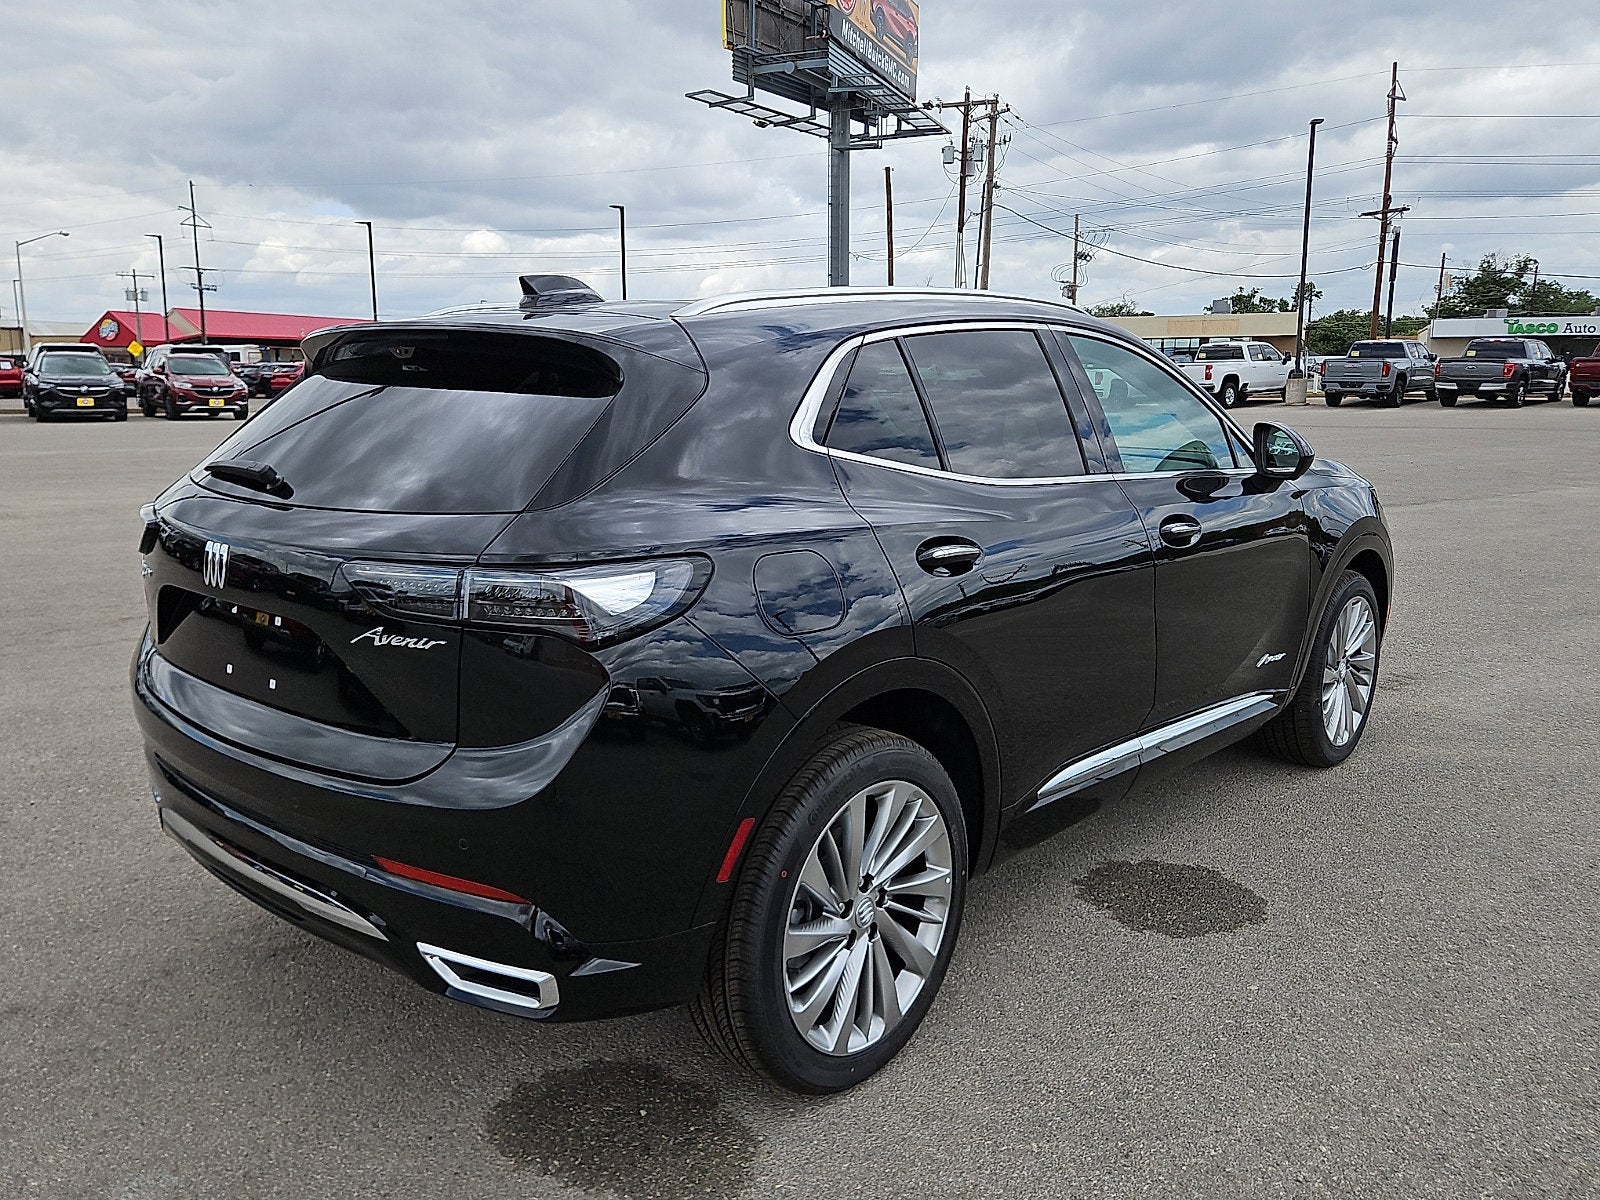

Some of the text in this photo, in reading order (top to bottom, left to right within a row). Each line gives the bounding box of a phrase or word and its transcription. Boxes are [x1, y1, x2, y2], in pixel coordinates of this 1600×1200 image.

[841, 19, 910, 88] MitchellBuickGMC.com
[1504, 319, 1597, 334] TASCO Auto
[350, 626, 447, 649] Avenir
